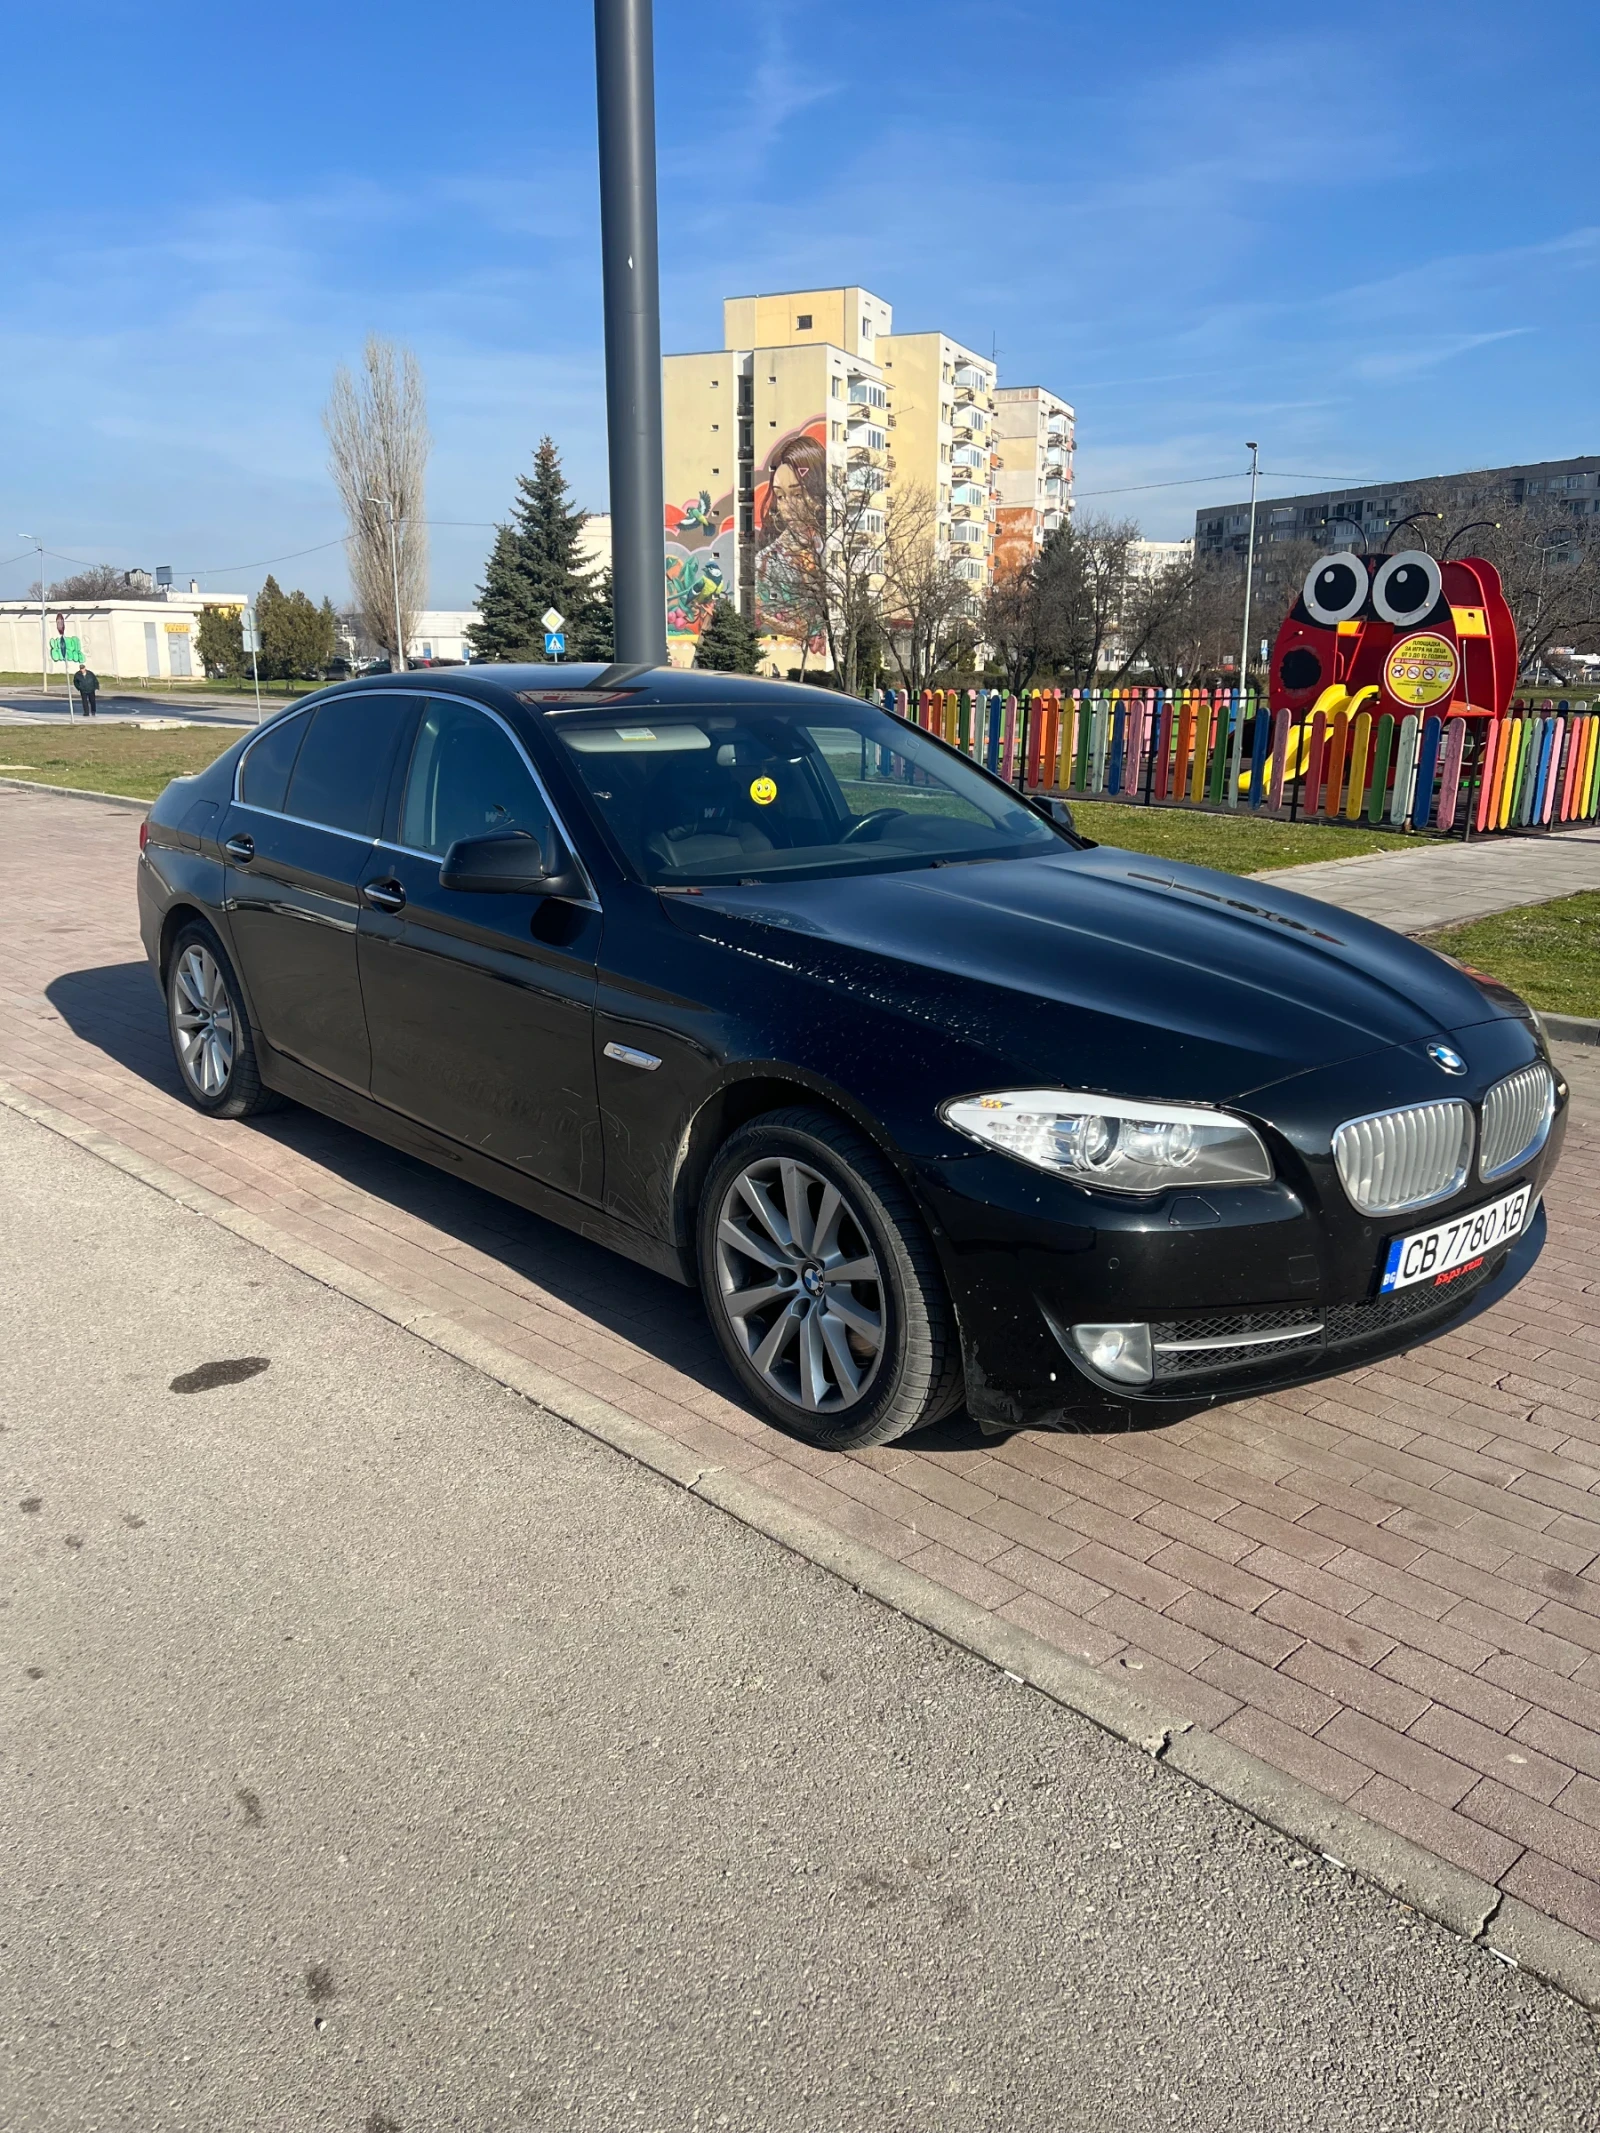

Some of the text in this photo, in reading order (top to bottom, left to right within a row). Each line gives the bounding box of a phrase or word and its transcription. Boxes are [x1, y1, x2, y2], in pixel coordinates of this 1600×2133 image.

[1403, 1193, 1525, 1279] CB 7780 XB
[1382, 1272, 1397, 1286] BG
